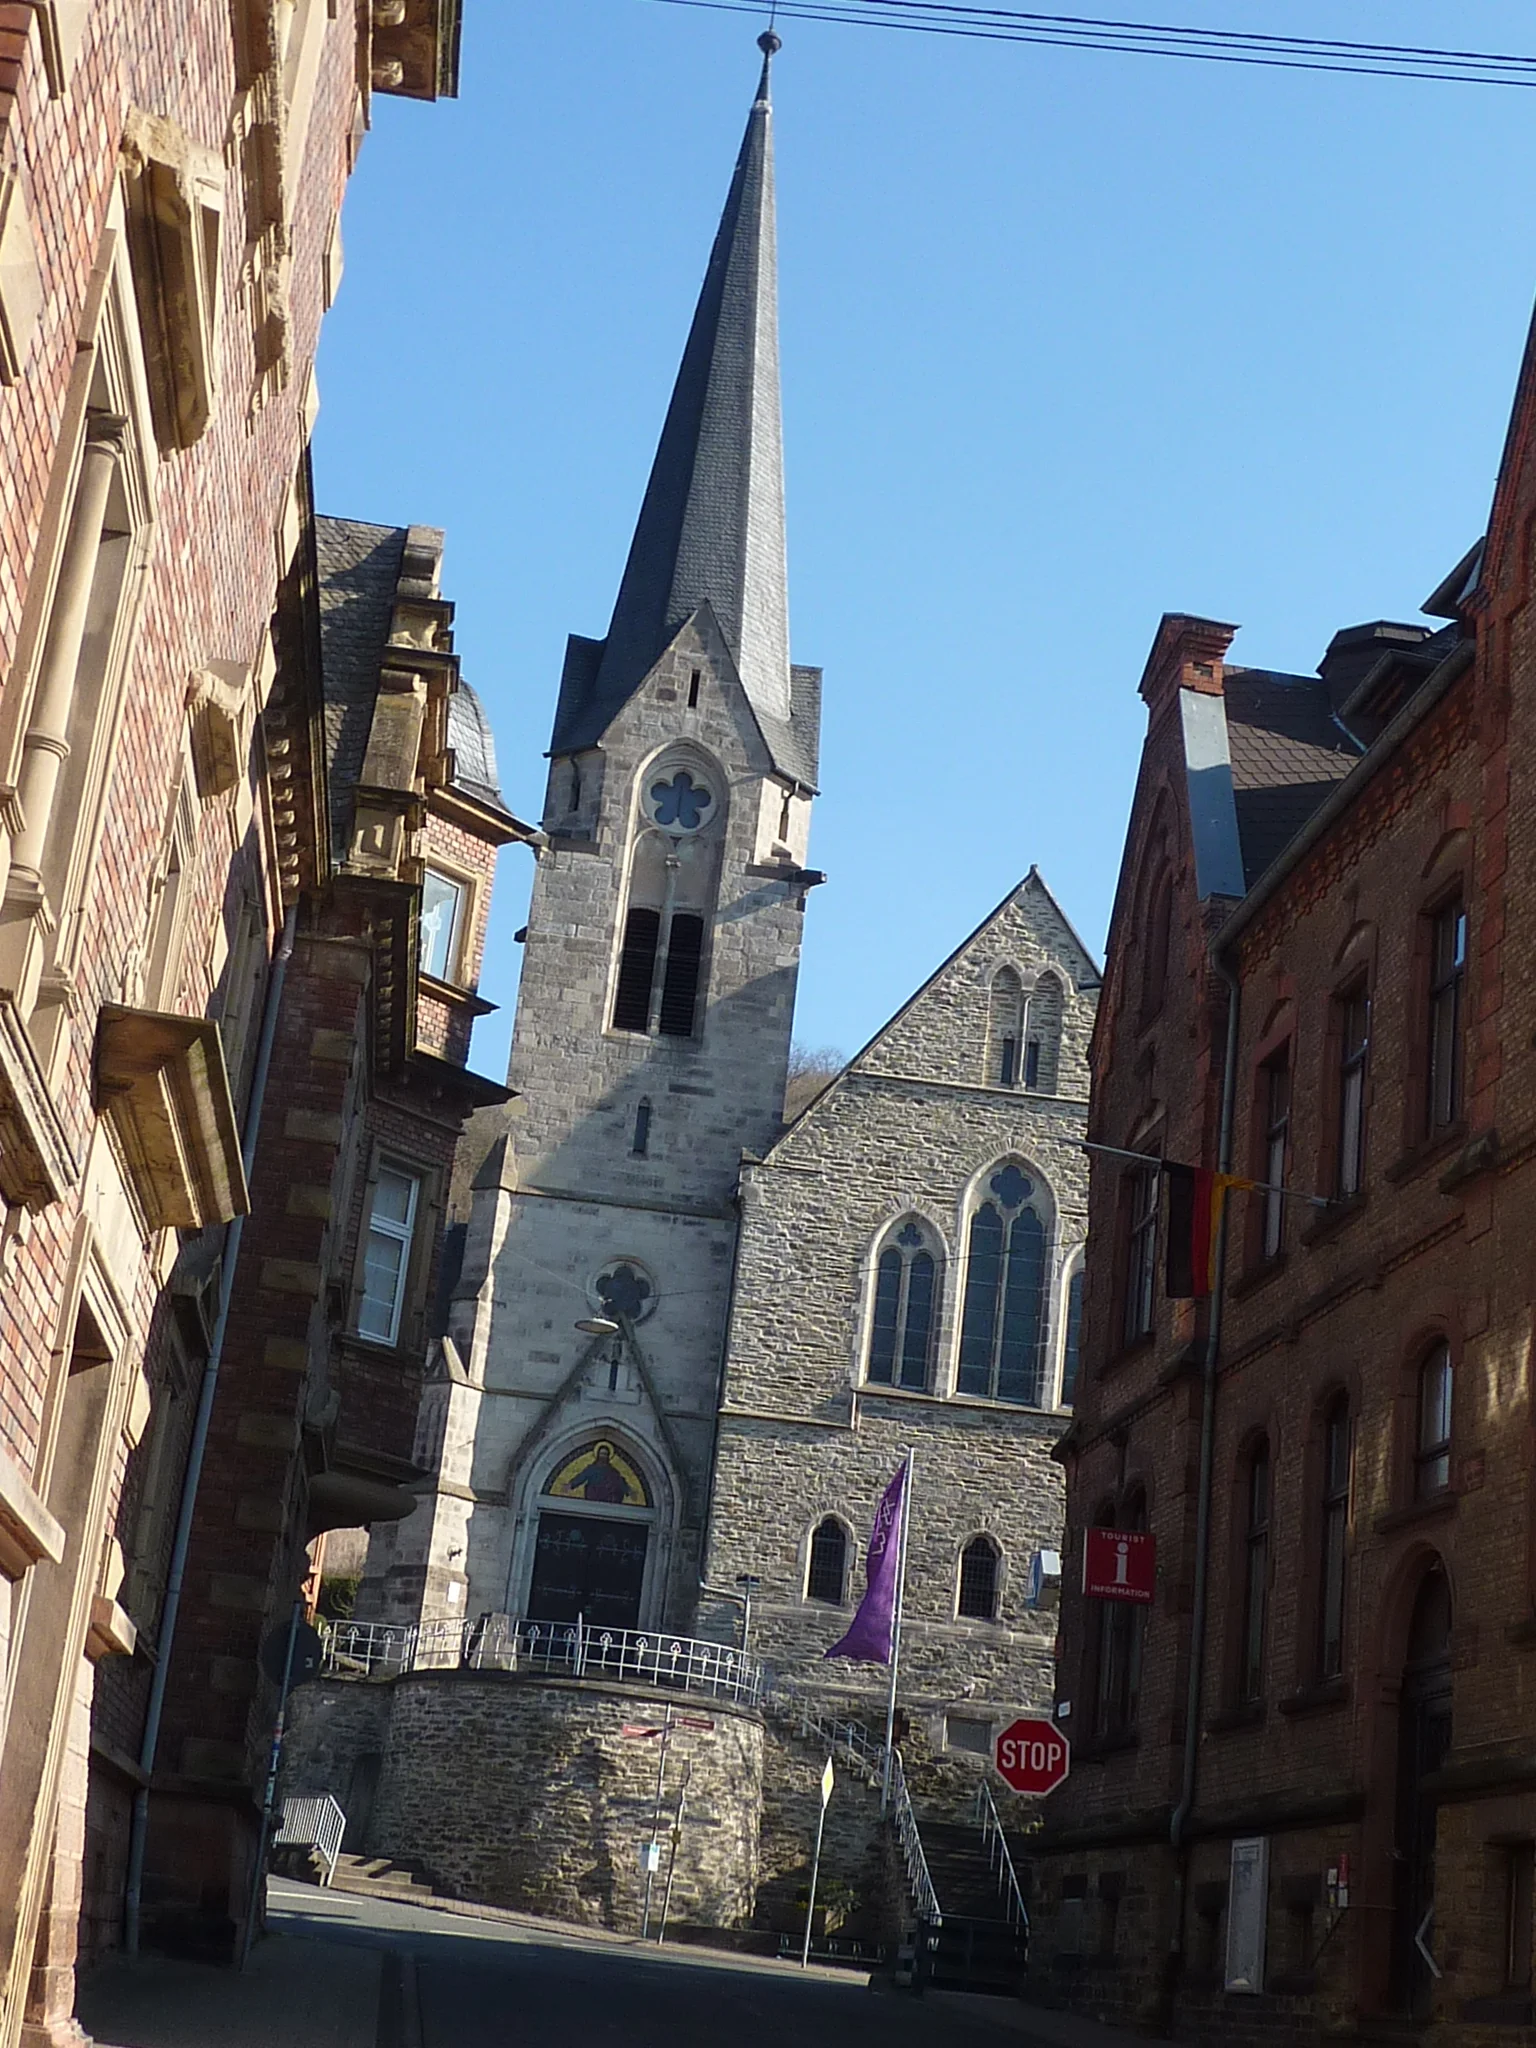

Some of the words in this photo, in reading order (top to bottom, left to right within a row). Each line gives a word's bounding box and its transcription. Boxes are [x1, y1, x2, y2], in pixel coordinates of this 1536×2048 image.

[1101, 1532, 1145, 1543] TOURIST
[1090, 1584, 1150, 1598] INFORMATION
[1001, 1739, 1062, 1772] STOP
